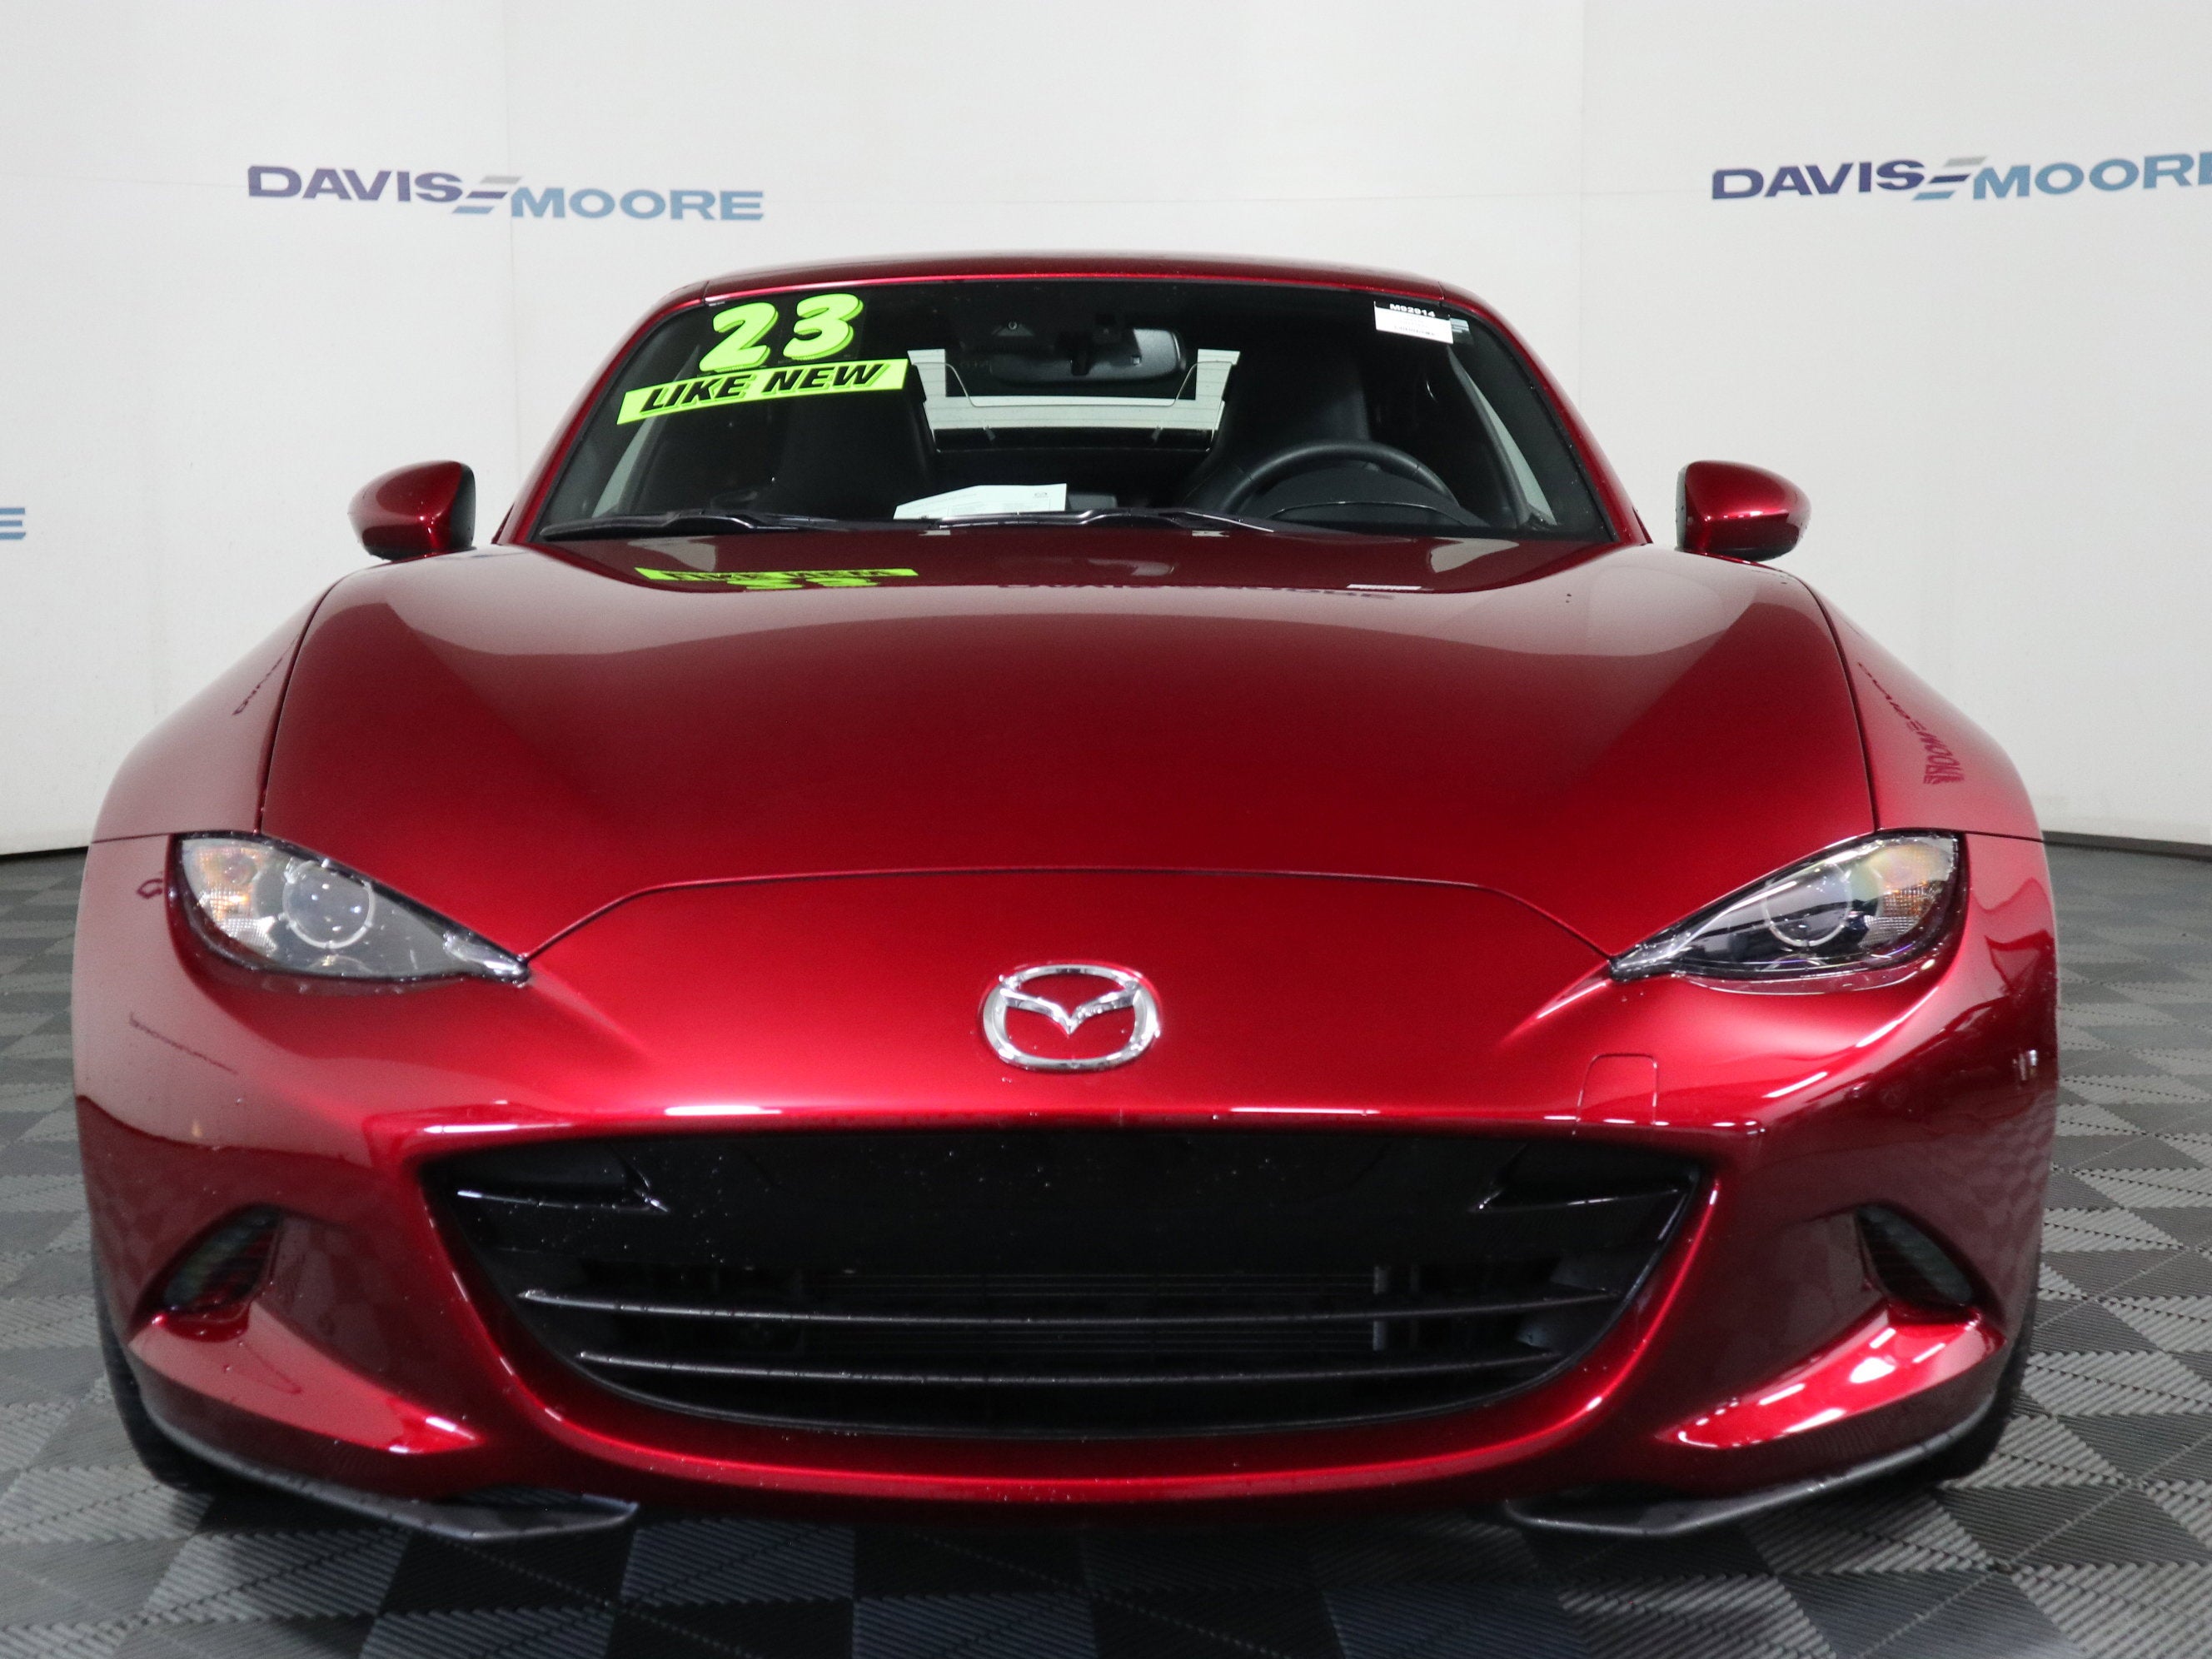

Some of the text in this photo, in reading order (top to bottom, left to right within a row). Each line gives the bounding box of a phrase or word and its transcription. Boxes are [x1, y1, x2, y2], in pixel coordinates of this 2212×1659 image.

[248, 165, 765, 221] DAVIS MOORE
[1712, 159, 1926, 200] DAVIS
[699, 292, 864, 373] 23
[640, 362, 890, 416] LIKE NEW
